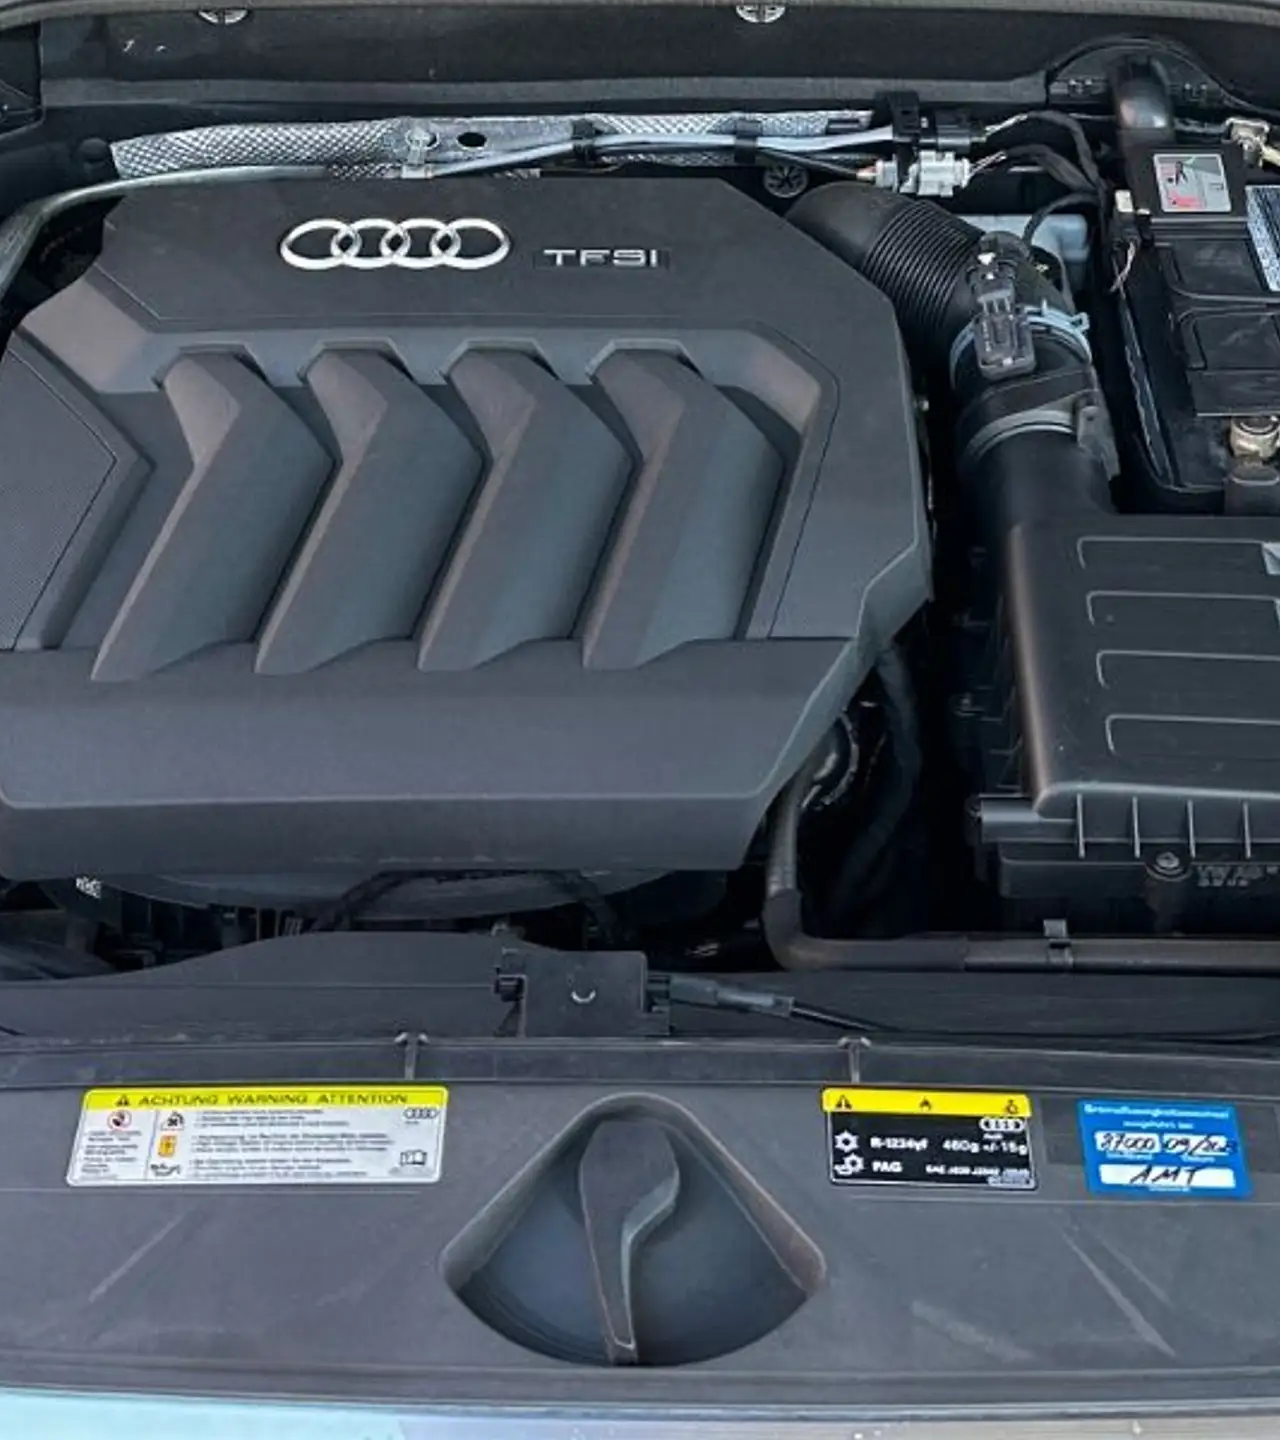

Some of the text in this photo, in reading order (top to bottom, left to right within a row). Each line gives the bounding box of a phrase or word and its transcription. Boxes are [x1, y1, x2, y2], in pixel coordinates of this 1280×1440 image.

[542, 248, 658, 268] TFSI
[138, 1093, 408, 1107] ACHTUNG WARNING ATTENTION
[872, 1160, 904, 1173] PAG
